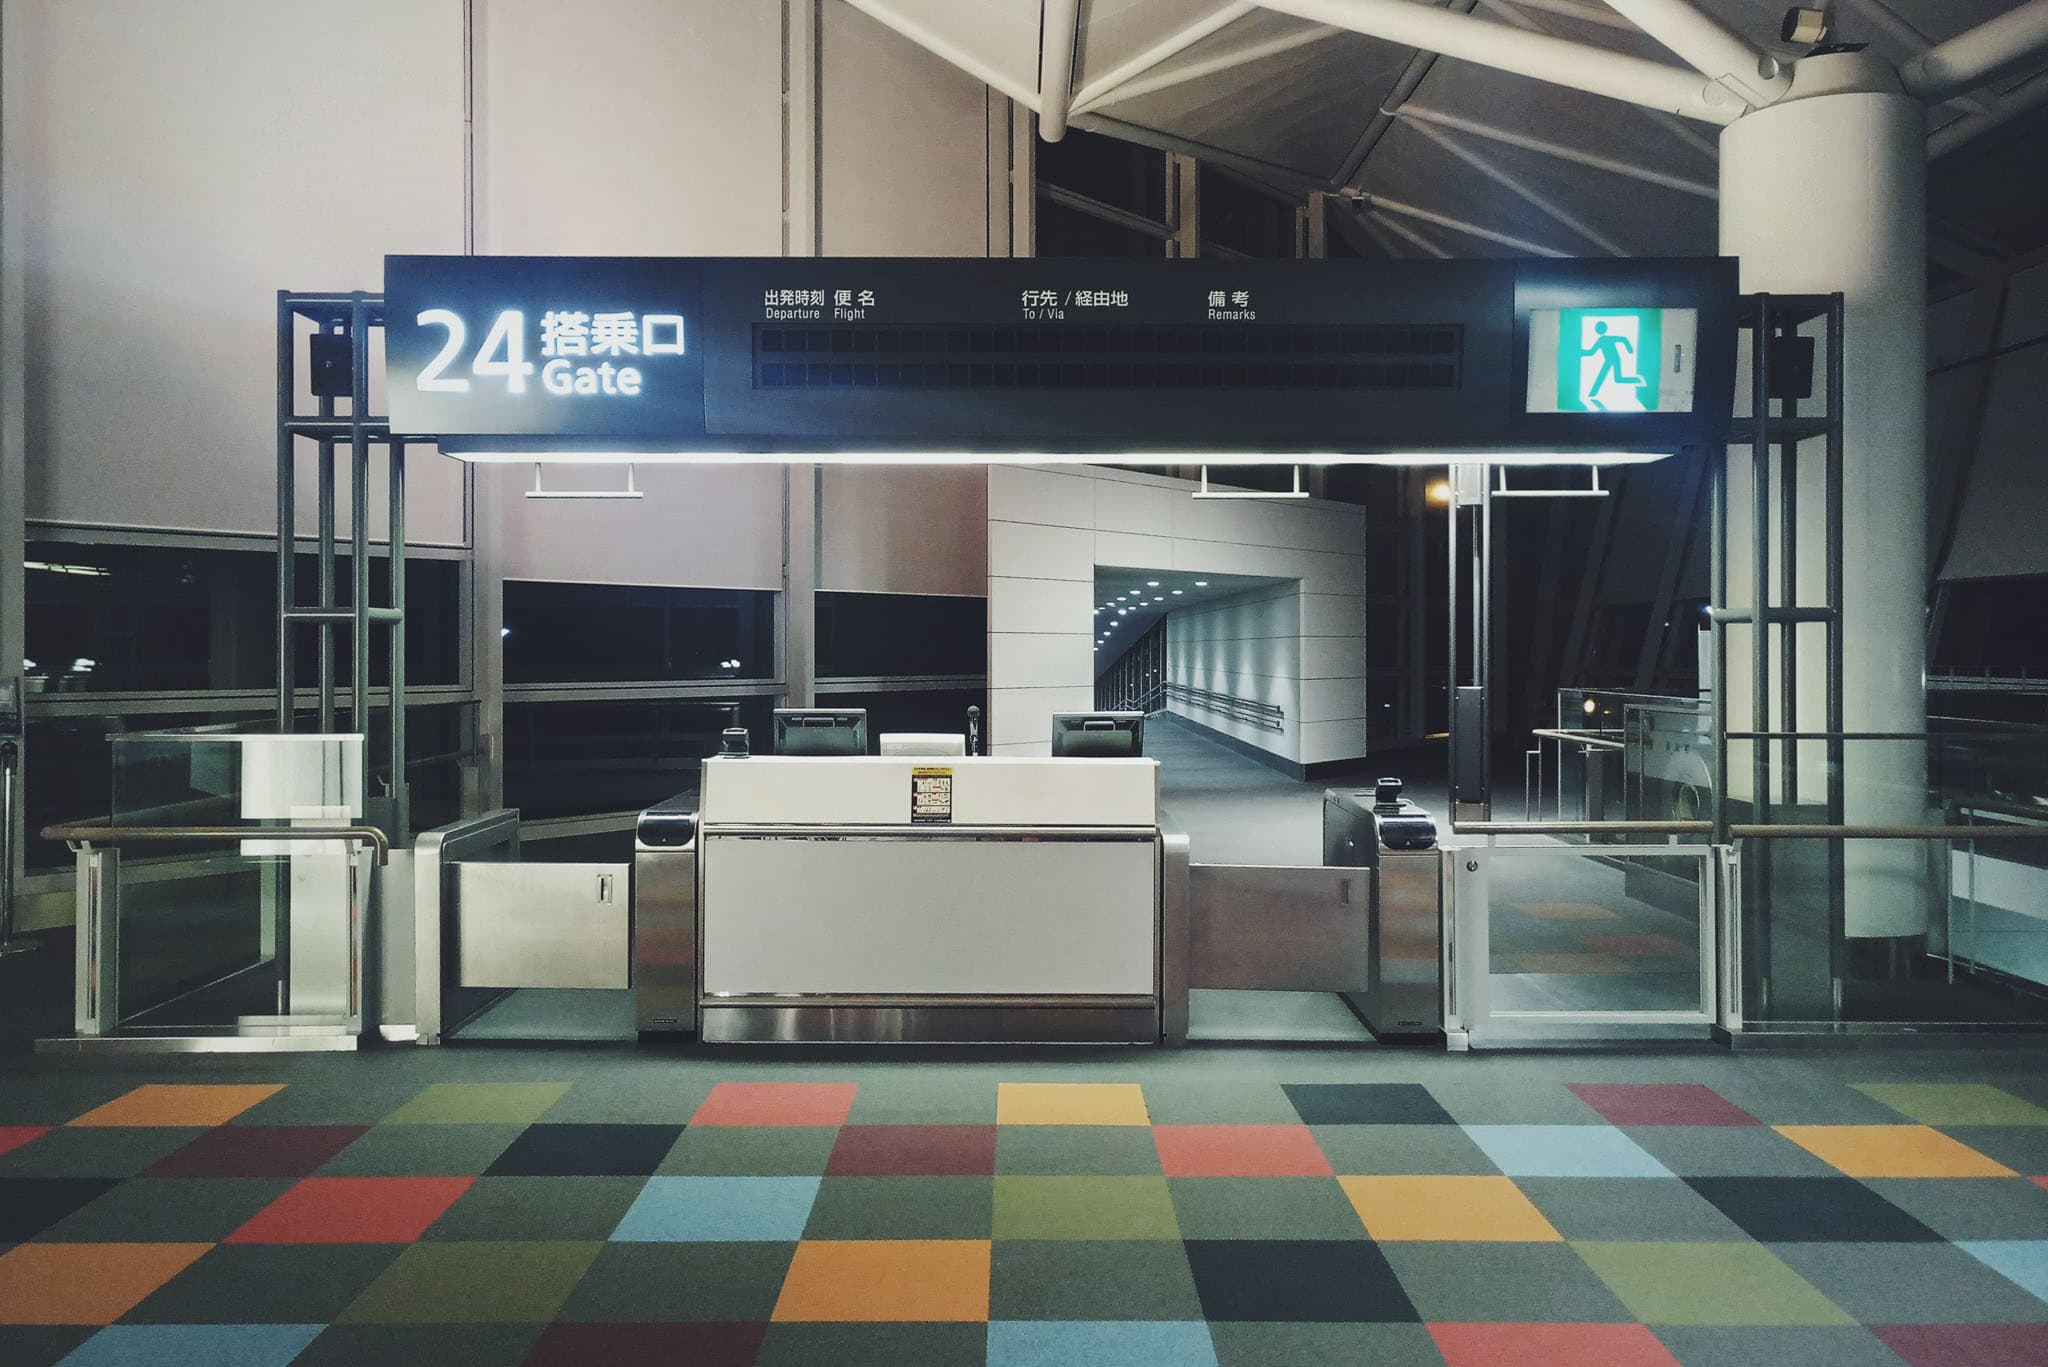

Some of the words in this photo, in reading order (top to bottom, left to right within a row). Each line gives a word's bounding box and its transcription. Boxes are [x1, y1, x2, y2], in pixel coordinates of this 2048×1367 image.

[764, 289, 825, 306] 出発時刻
[766, 308, 820, 321] Departure
[834, 308, 865, 321] Flight
[1023, 308, 1035, 320] To
[1047, 308, 1065, 320] Via
[1208, 308, 1256, 320] Remarks
[541, 311, 685, 356] 搭乗口
[416, 309, 533, 395] 24
[541, 359, 643, 396] Gate
